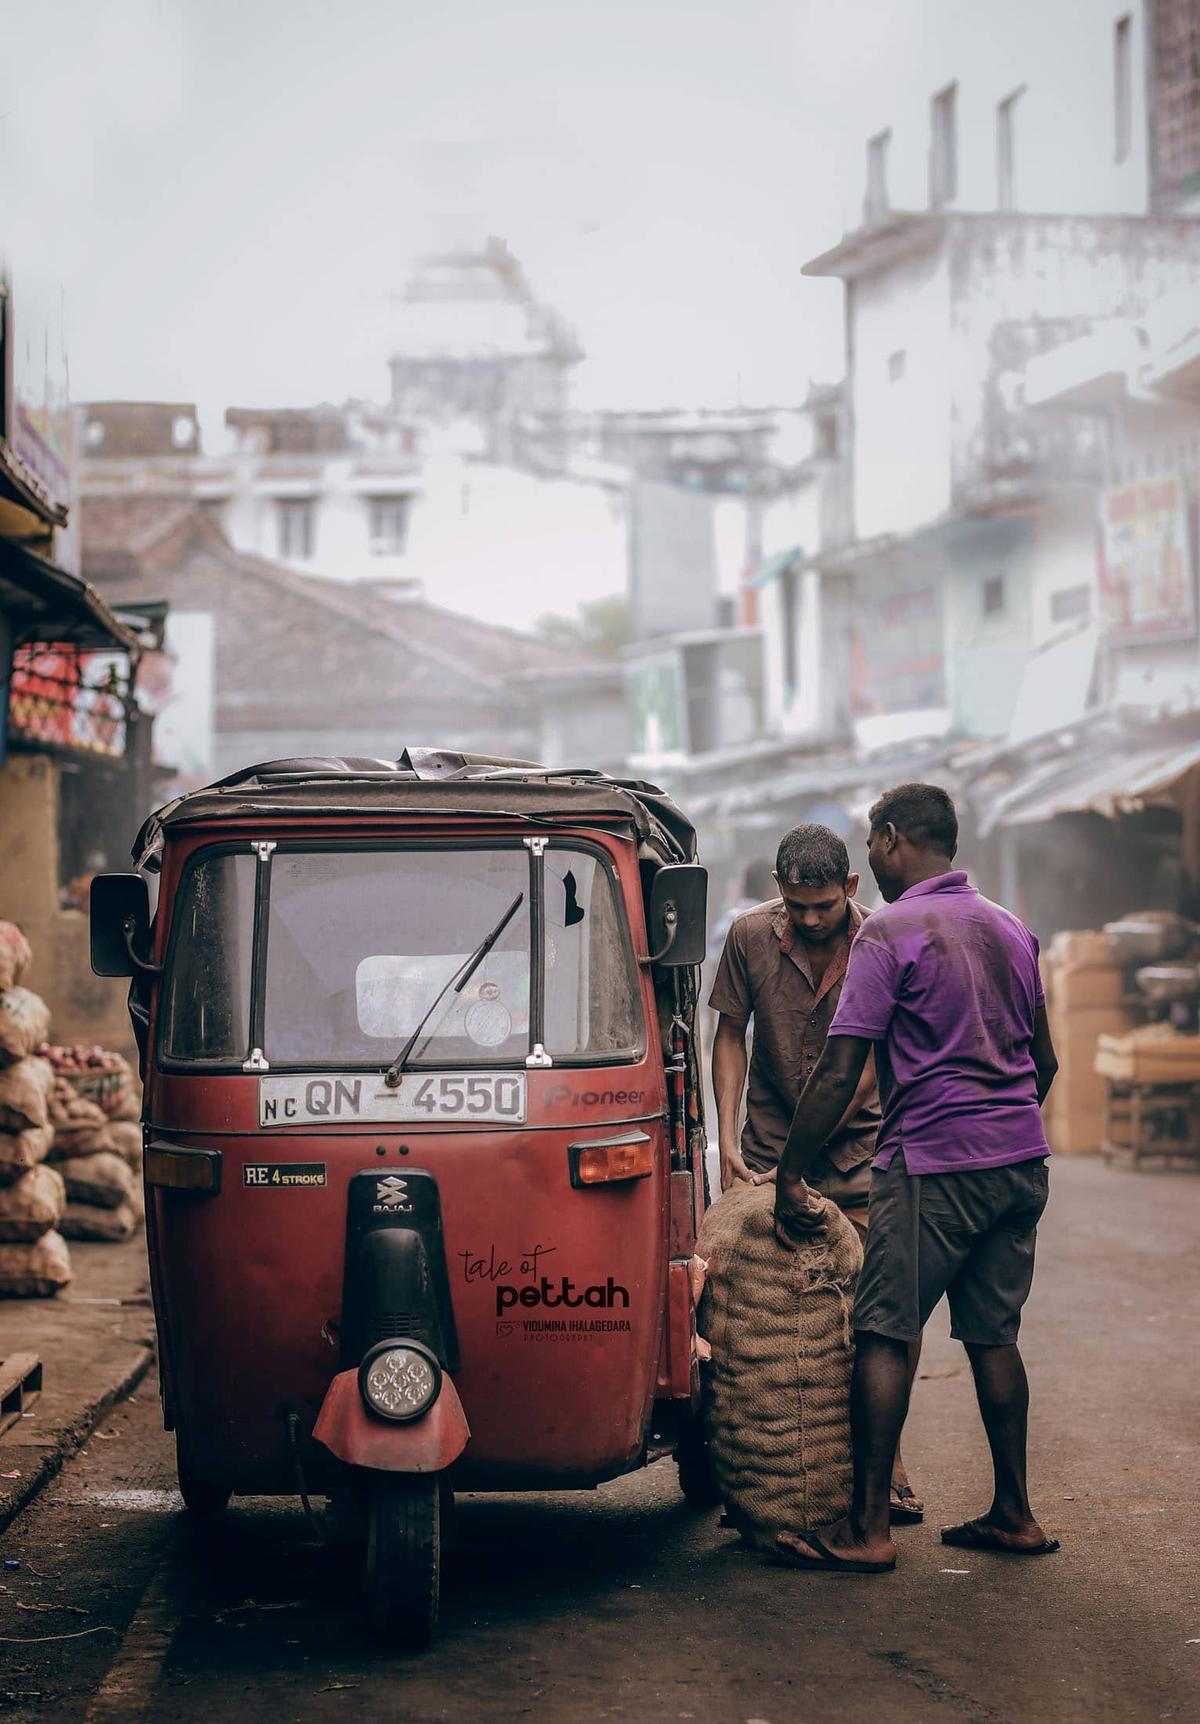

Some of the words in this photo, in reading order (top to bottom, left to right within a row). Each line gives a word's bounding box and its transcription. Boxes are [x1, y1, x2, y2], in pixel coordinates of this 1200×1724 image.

[305, 1080, 362, 1115] QN
[413, 1078, 520, 1115] 4550
[544, 1084, 645, 1110] Pioneer
[246, 1167, 269, 1184] RE
[272, 1169, 281, 1184] 4
[282, 1174, 325, 1185] STROKE
[373, 1204, 412, 1212] BAJAJ
